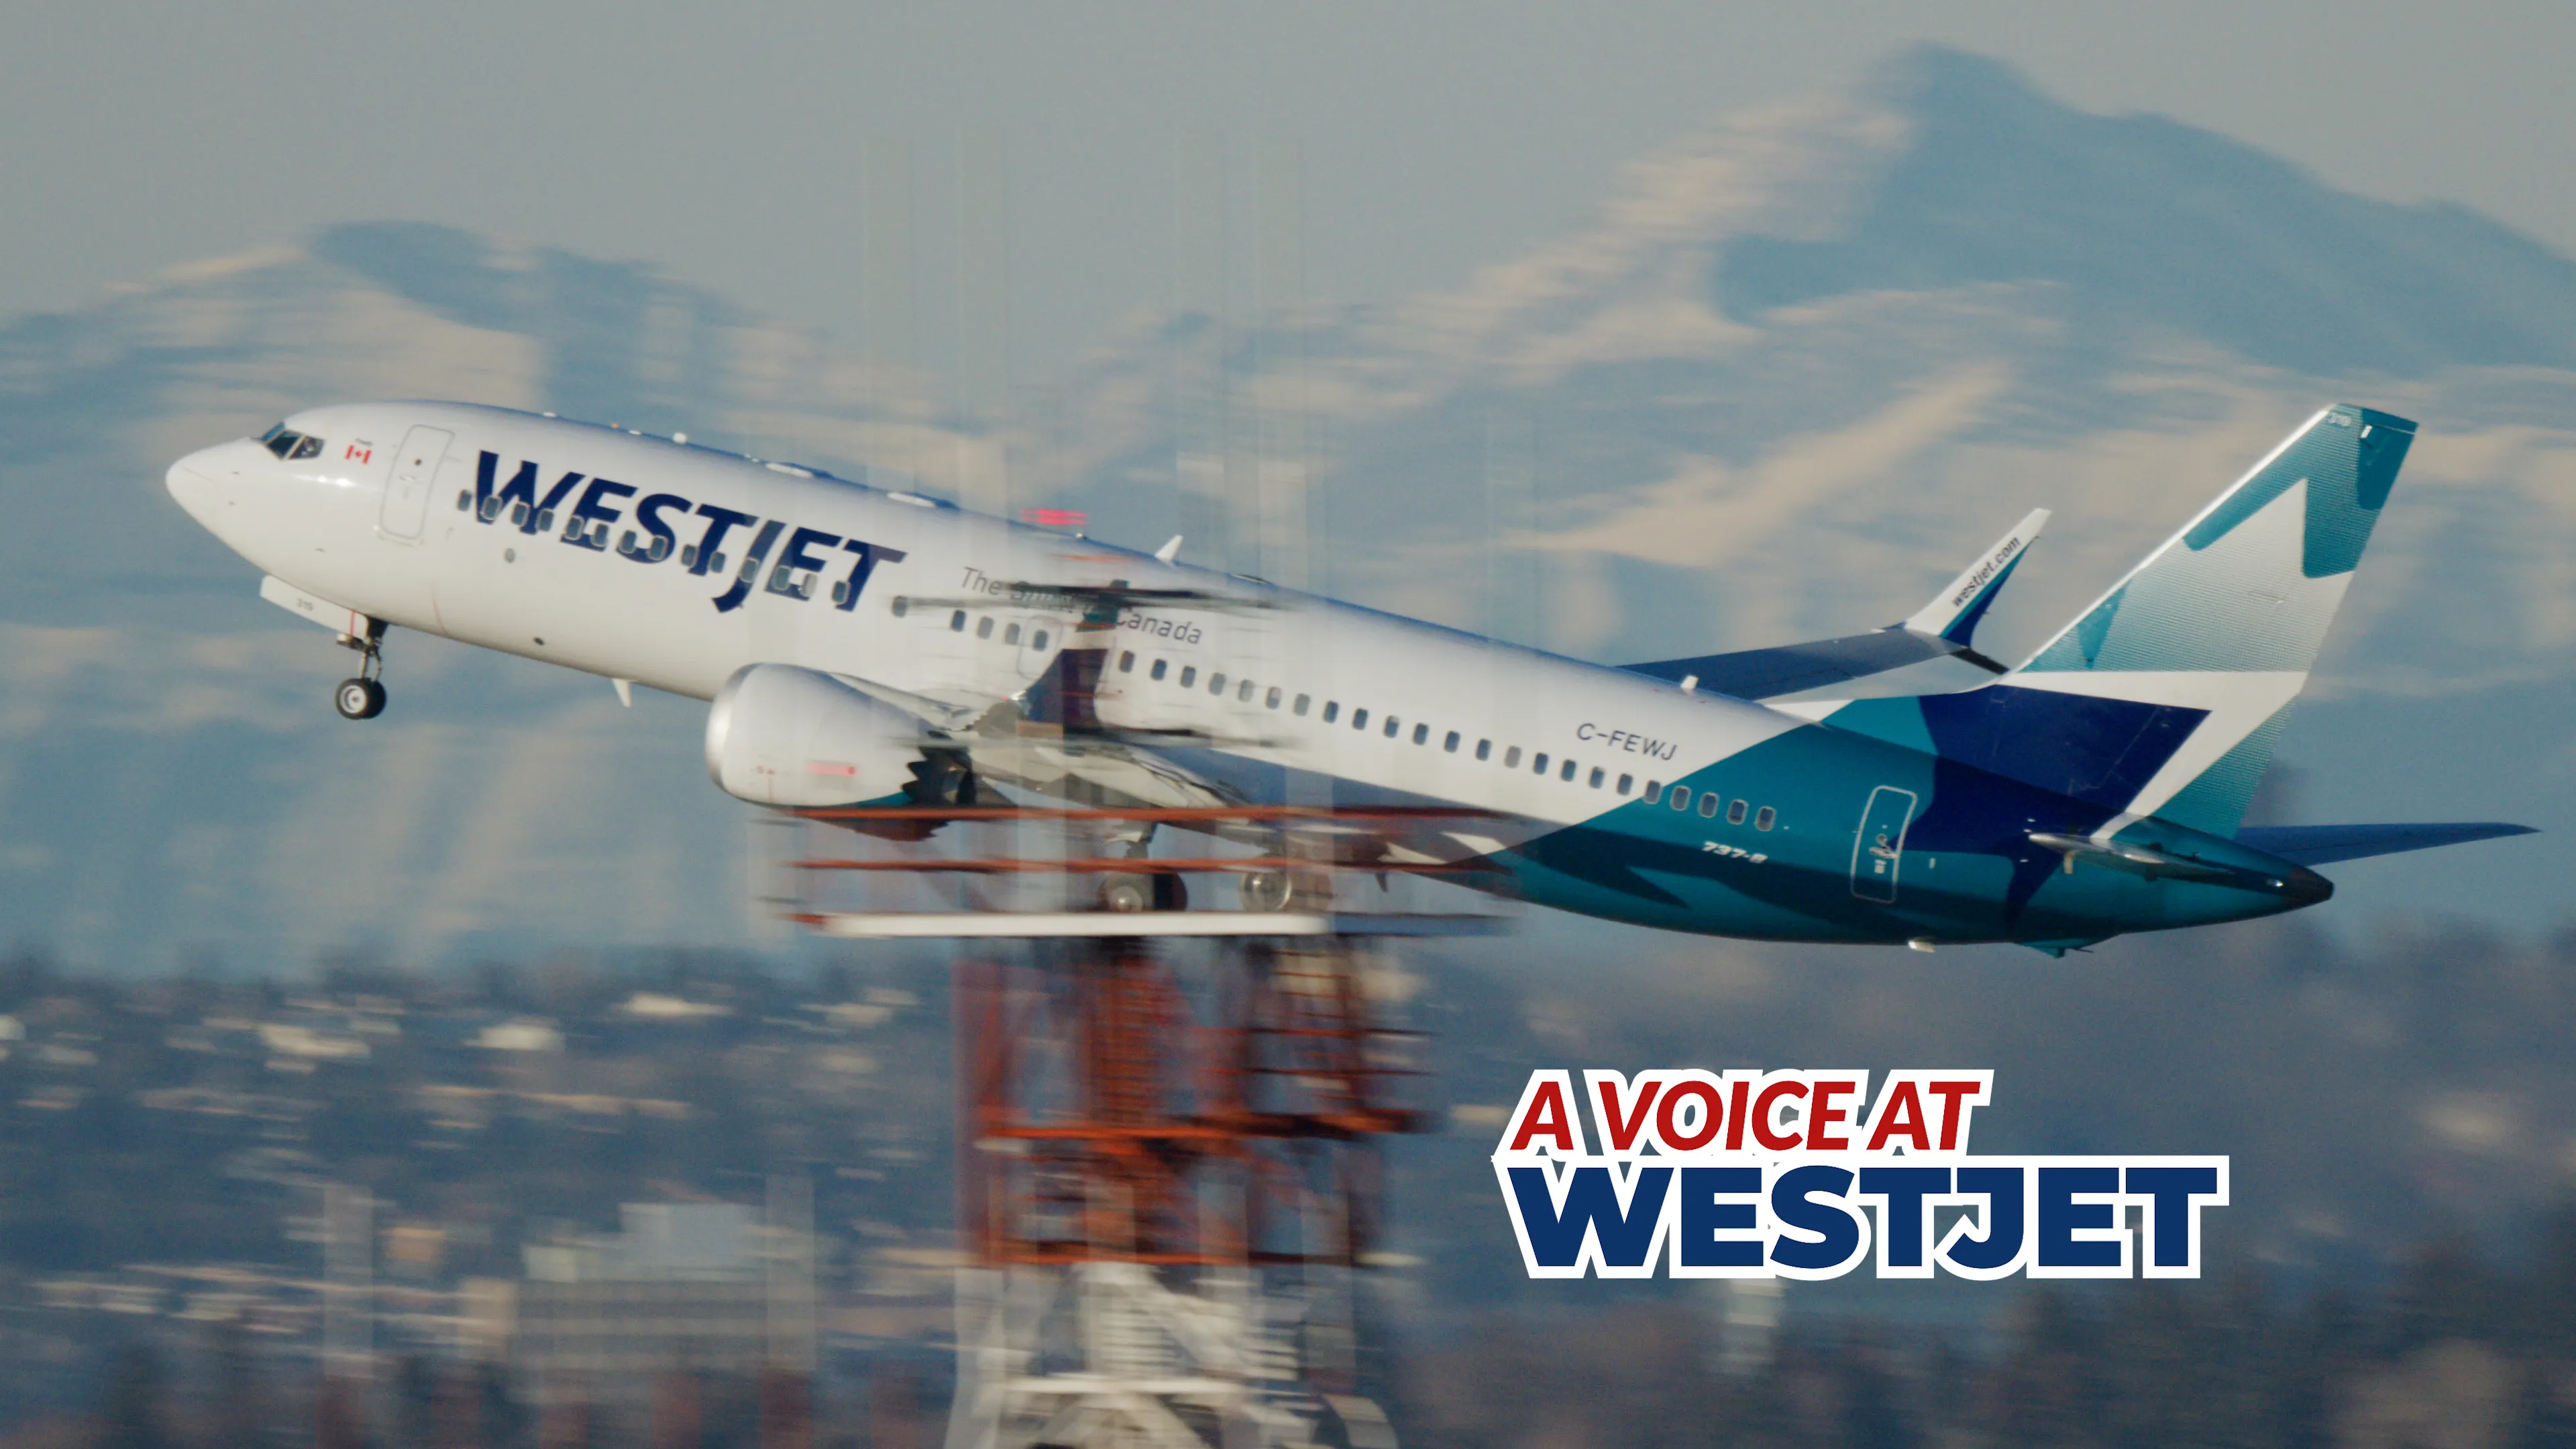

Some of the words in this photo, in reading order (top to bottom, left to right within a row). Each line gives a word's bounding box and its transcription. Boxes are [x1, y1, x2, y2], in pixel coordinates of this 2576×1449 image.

[476, 450, 908, 613] WESTJET
[961, 566, 1003, 596] The
[1952, 537, 2021, 606] westjet.com
[1576, 722, 1678, 761] C-FEWJ
